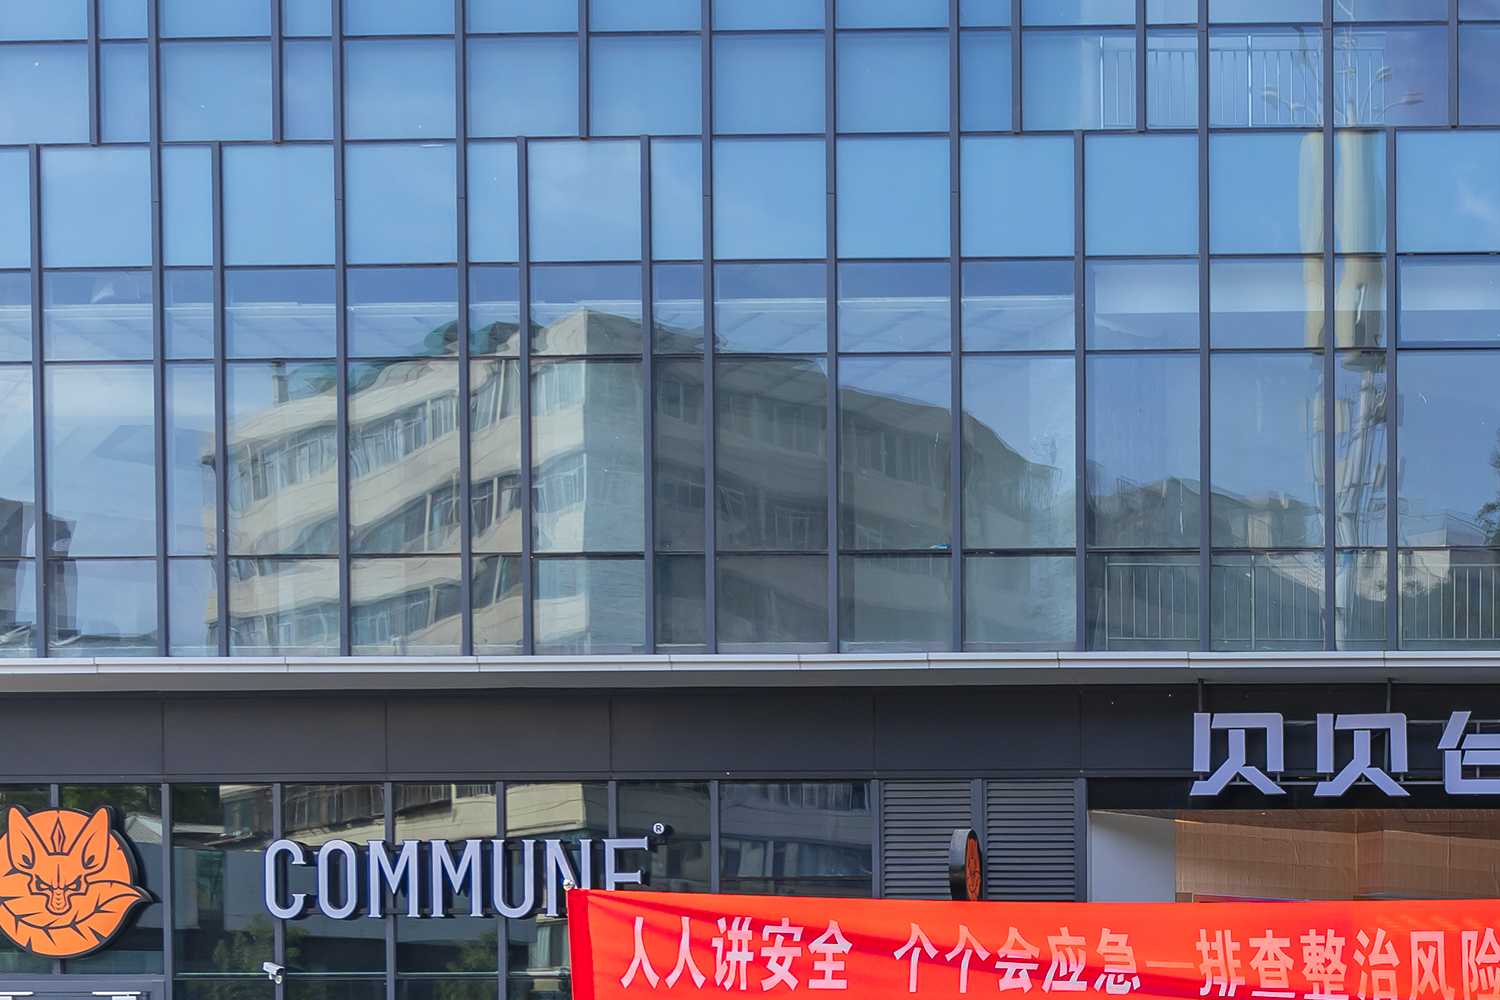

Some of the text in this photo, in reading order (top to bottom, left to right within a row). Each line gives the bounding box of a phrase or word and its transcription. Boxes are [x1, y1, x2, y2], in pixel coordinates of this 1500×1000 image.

[621, 916, 852, 991] 人人讲安全
